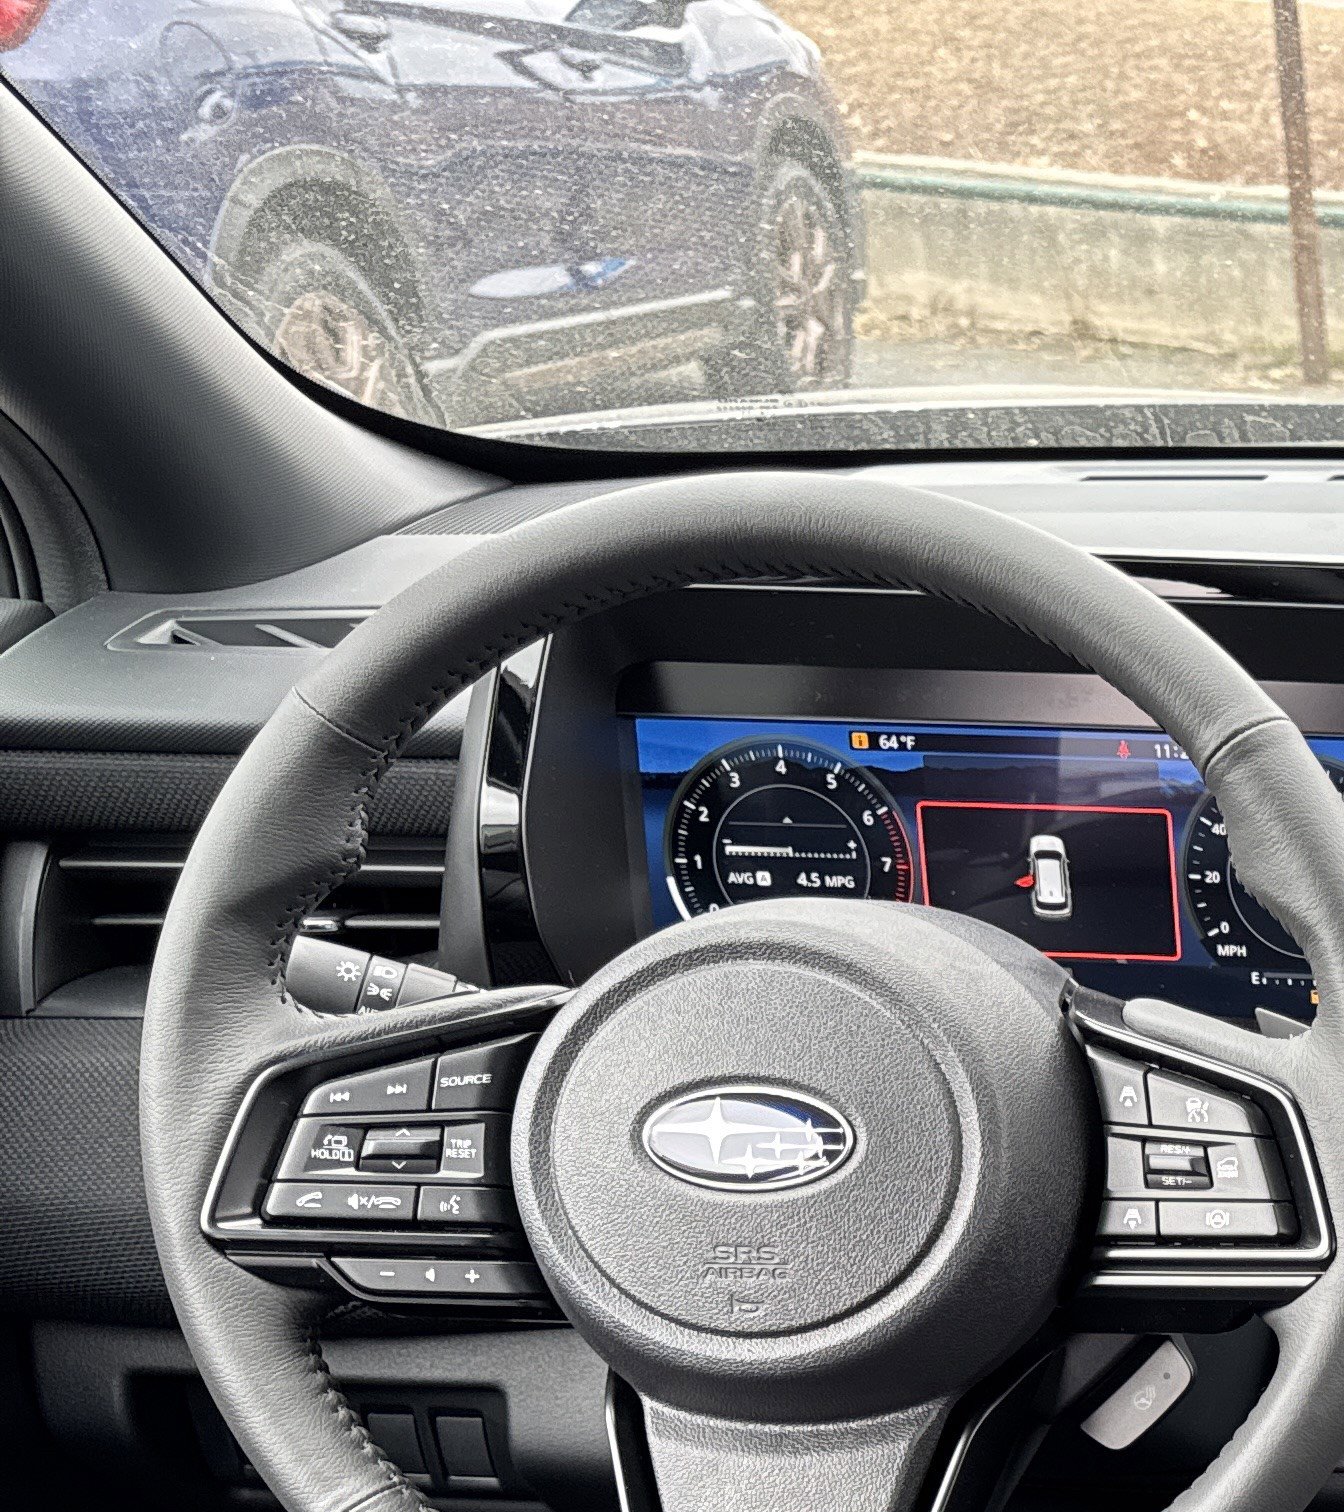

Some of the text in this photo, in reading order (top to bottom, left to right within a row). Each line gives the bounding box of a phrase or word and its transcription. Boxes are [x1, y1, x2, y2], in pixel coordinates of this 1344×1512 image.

[878, 735, 916, 751] 64°F
[774, 760, 787, 775] 4
[729, 773, 740, 788] 3
[826, 774, 837, 789] 5
[698, 806, 709, 822] 2
[862, 810, 874, 826] 6
[1211, 823, 1227, 836] 40
[694, 854, 702, 870] 1
[880, 856, 892, 873] 7
[728, 871, 855, 889] AVG 4.5 MPG
[1204, 870, 1221, 883] 20
[1220, 921, 1230, 934] 0
[1216, 944, 1247, 958] MPH
[1250, 971, 1260, 985] E
[439, 1073, 493, 1088] SOURCE
[450, 1138, 472, 1149] TRIP
[446, 1148, 477, 1159] RESET
[712, 1244, 781, 1264] SRS
[701, 1266, 790, 1280] AIRBAG
